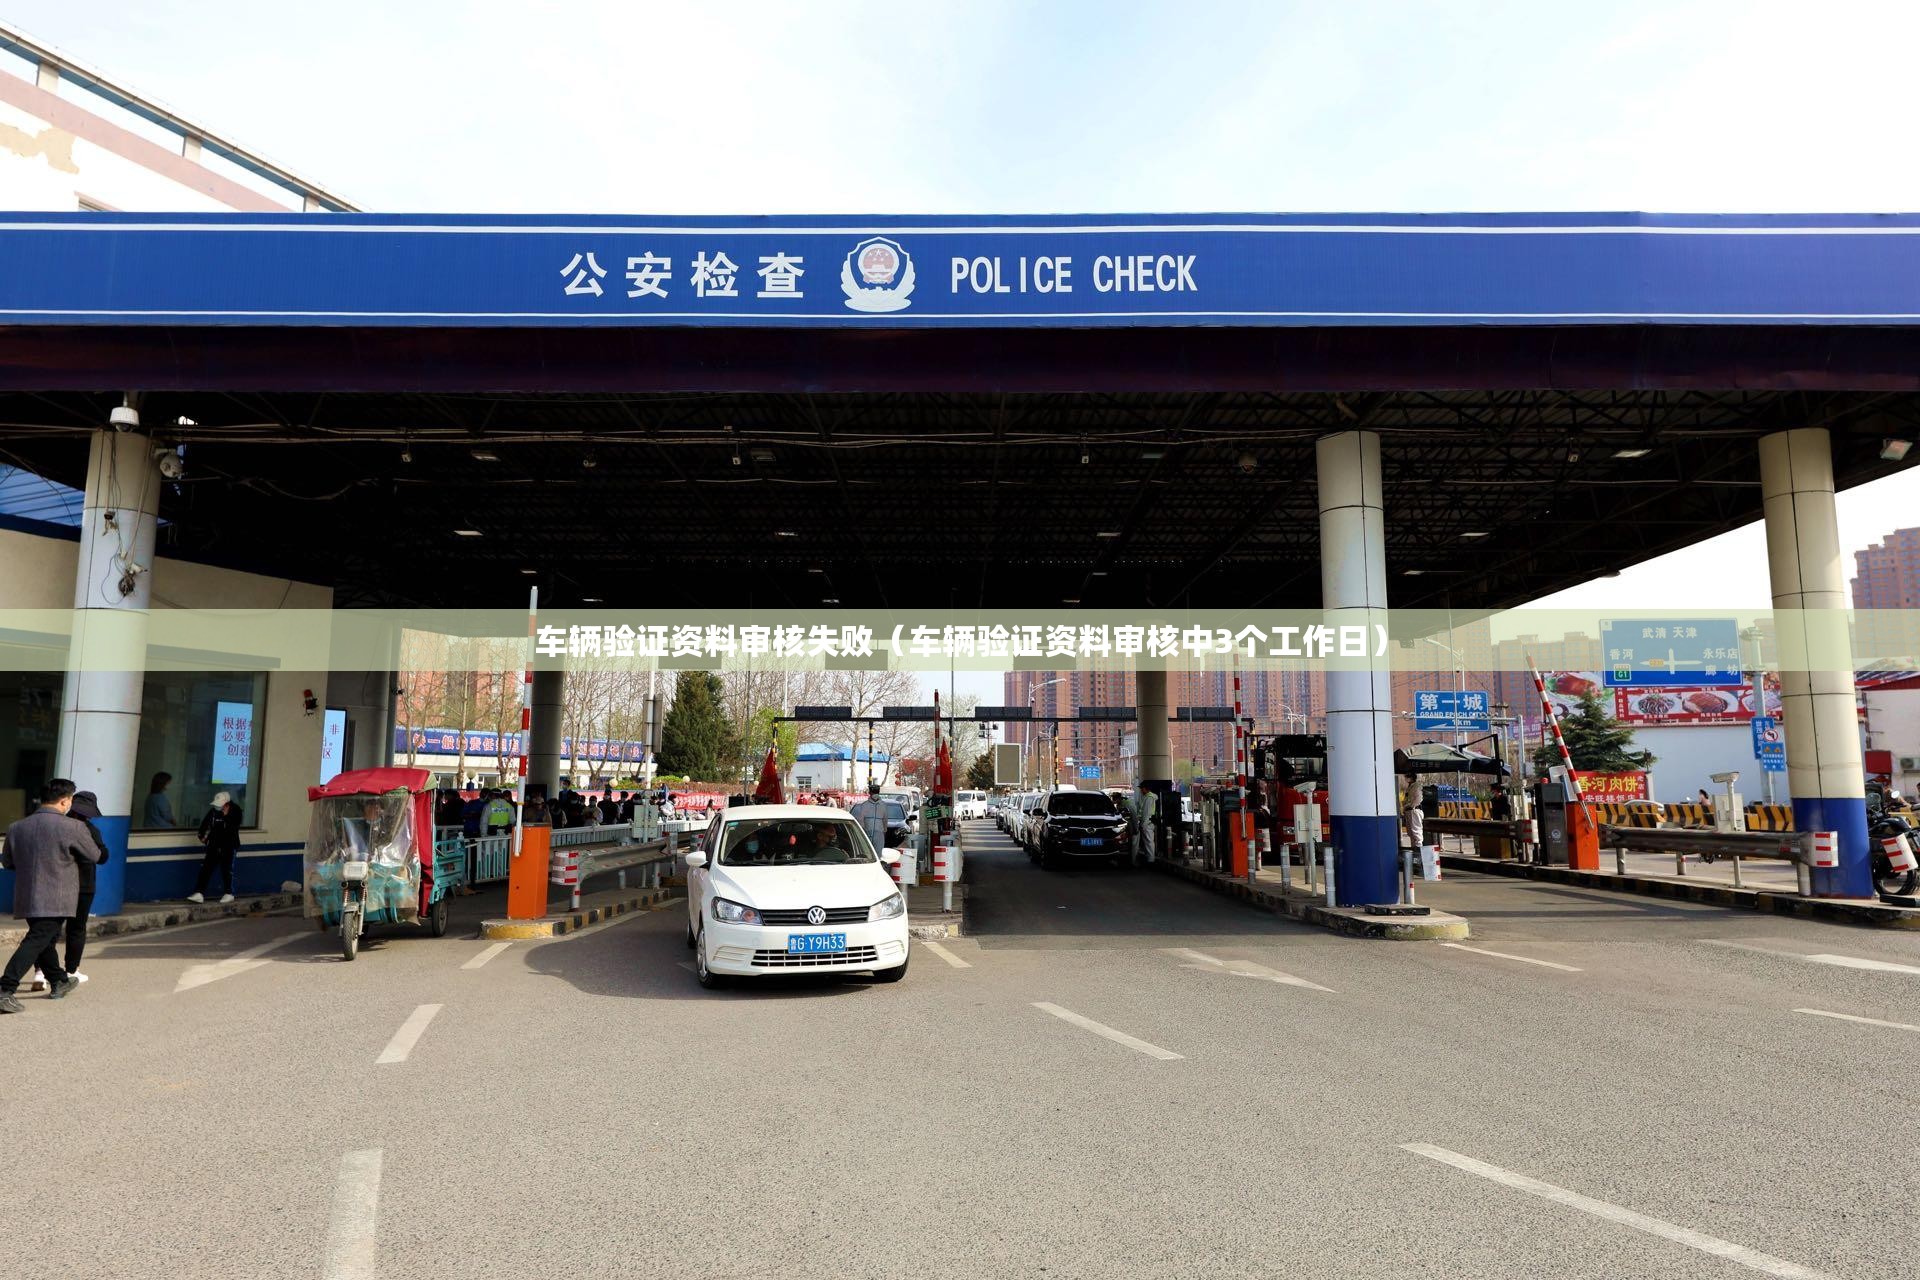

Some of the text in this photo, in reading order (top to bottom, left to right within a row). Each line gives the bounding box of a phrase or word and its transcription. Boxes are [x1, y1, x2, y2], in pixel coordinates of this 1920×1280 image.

[559, 251, 805, 299] 公安检查
[951, 254, 1198, 294] POLICE CHECK
[1642, 626, 1697, 639] 武清 天津
[1609, 648, 1634, 660] 香河
[1703, 648, 1738, 660] 永乐店
[1705, 664, 1738, 676] 廊坊
[1420, 693, 1483, 711] 第一城
[1420, 711, 1443, 719] GRAND
[1578, 776, 1638, 792] 香河肉饼
